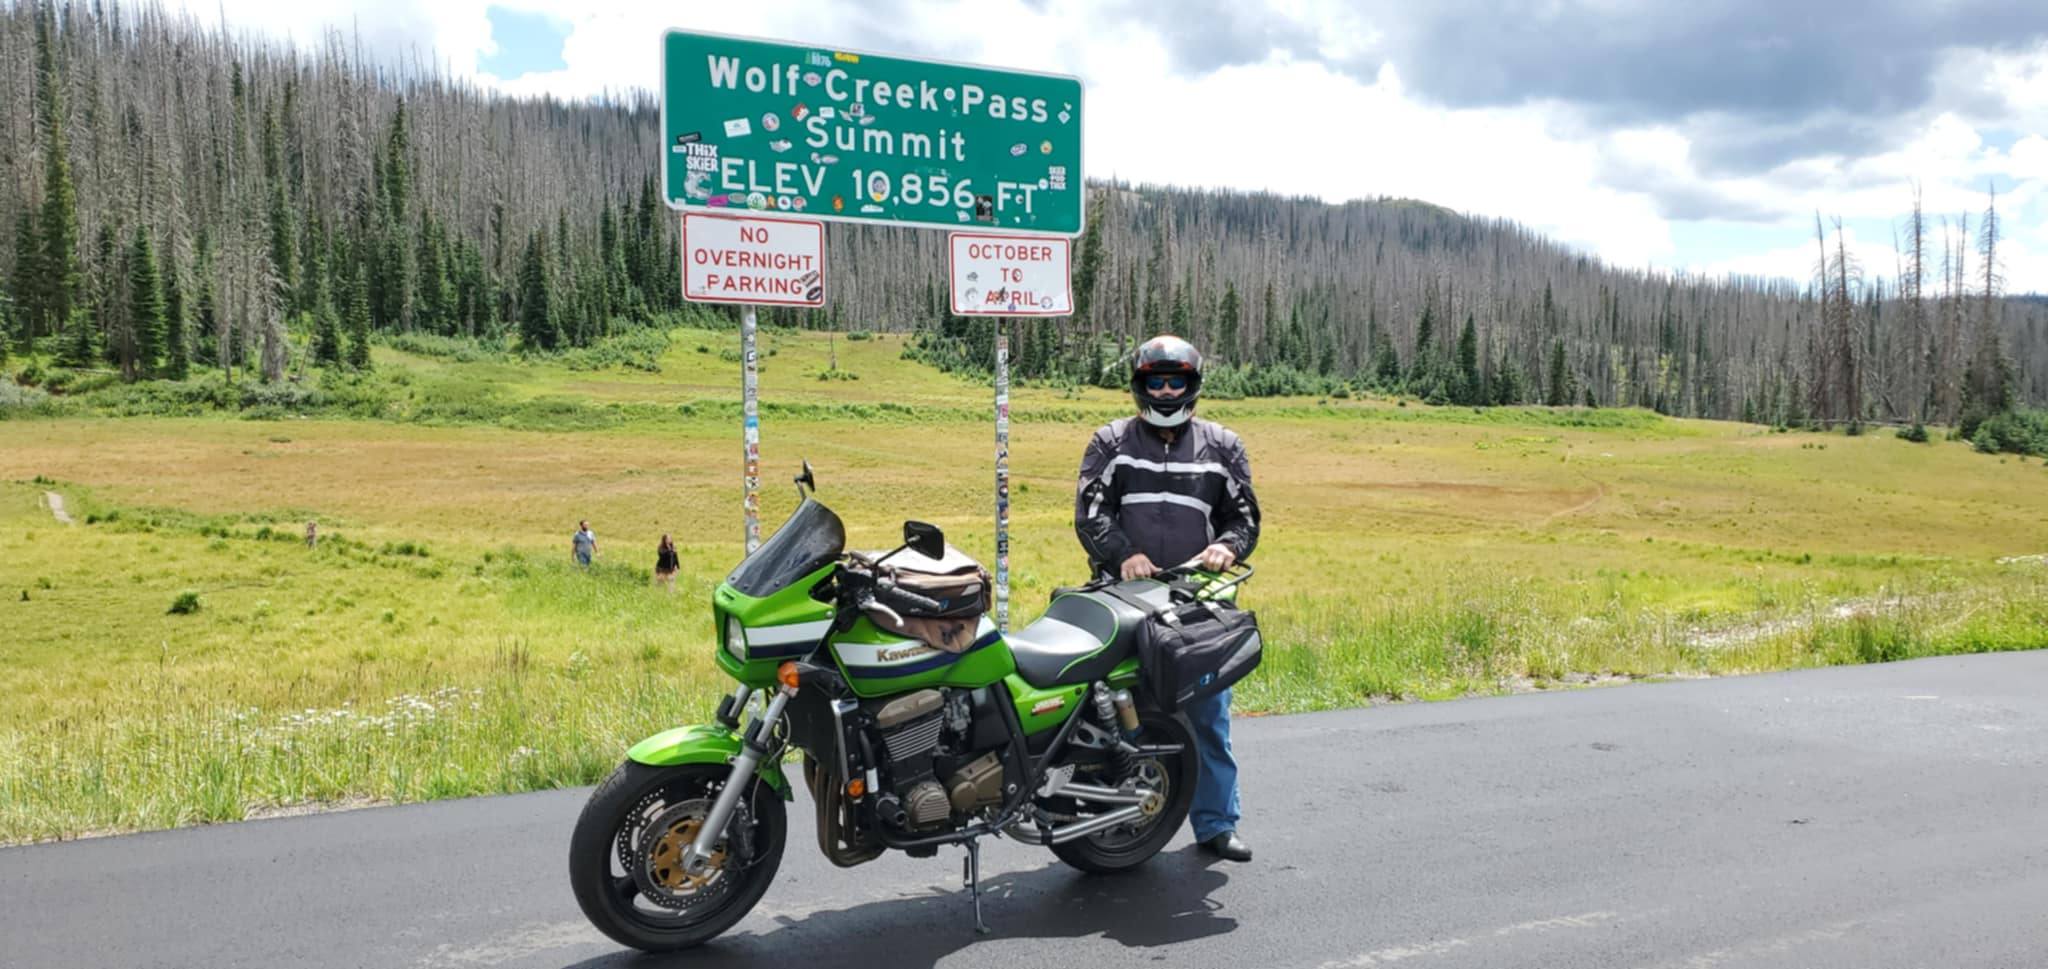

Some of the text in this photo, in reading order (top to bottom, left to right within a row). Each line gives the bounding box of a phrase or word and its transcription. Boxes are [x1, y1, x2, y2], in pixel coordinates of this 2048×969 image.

[707, 54, 1048, 123] Wolf Creek Pass
[806, 115, 965, 162] Summit
[721, 157, 1038, 214] ELEV 10,856 FT
[740, 227, 769, 244] NO
[694, 248, 814, 271] OVERNIGHT
[969, 243, 1053, 261] OCTOBER
[706, 273, 803, 295] PARKING
[1000, 267, 1024, 283] TO
